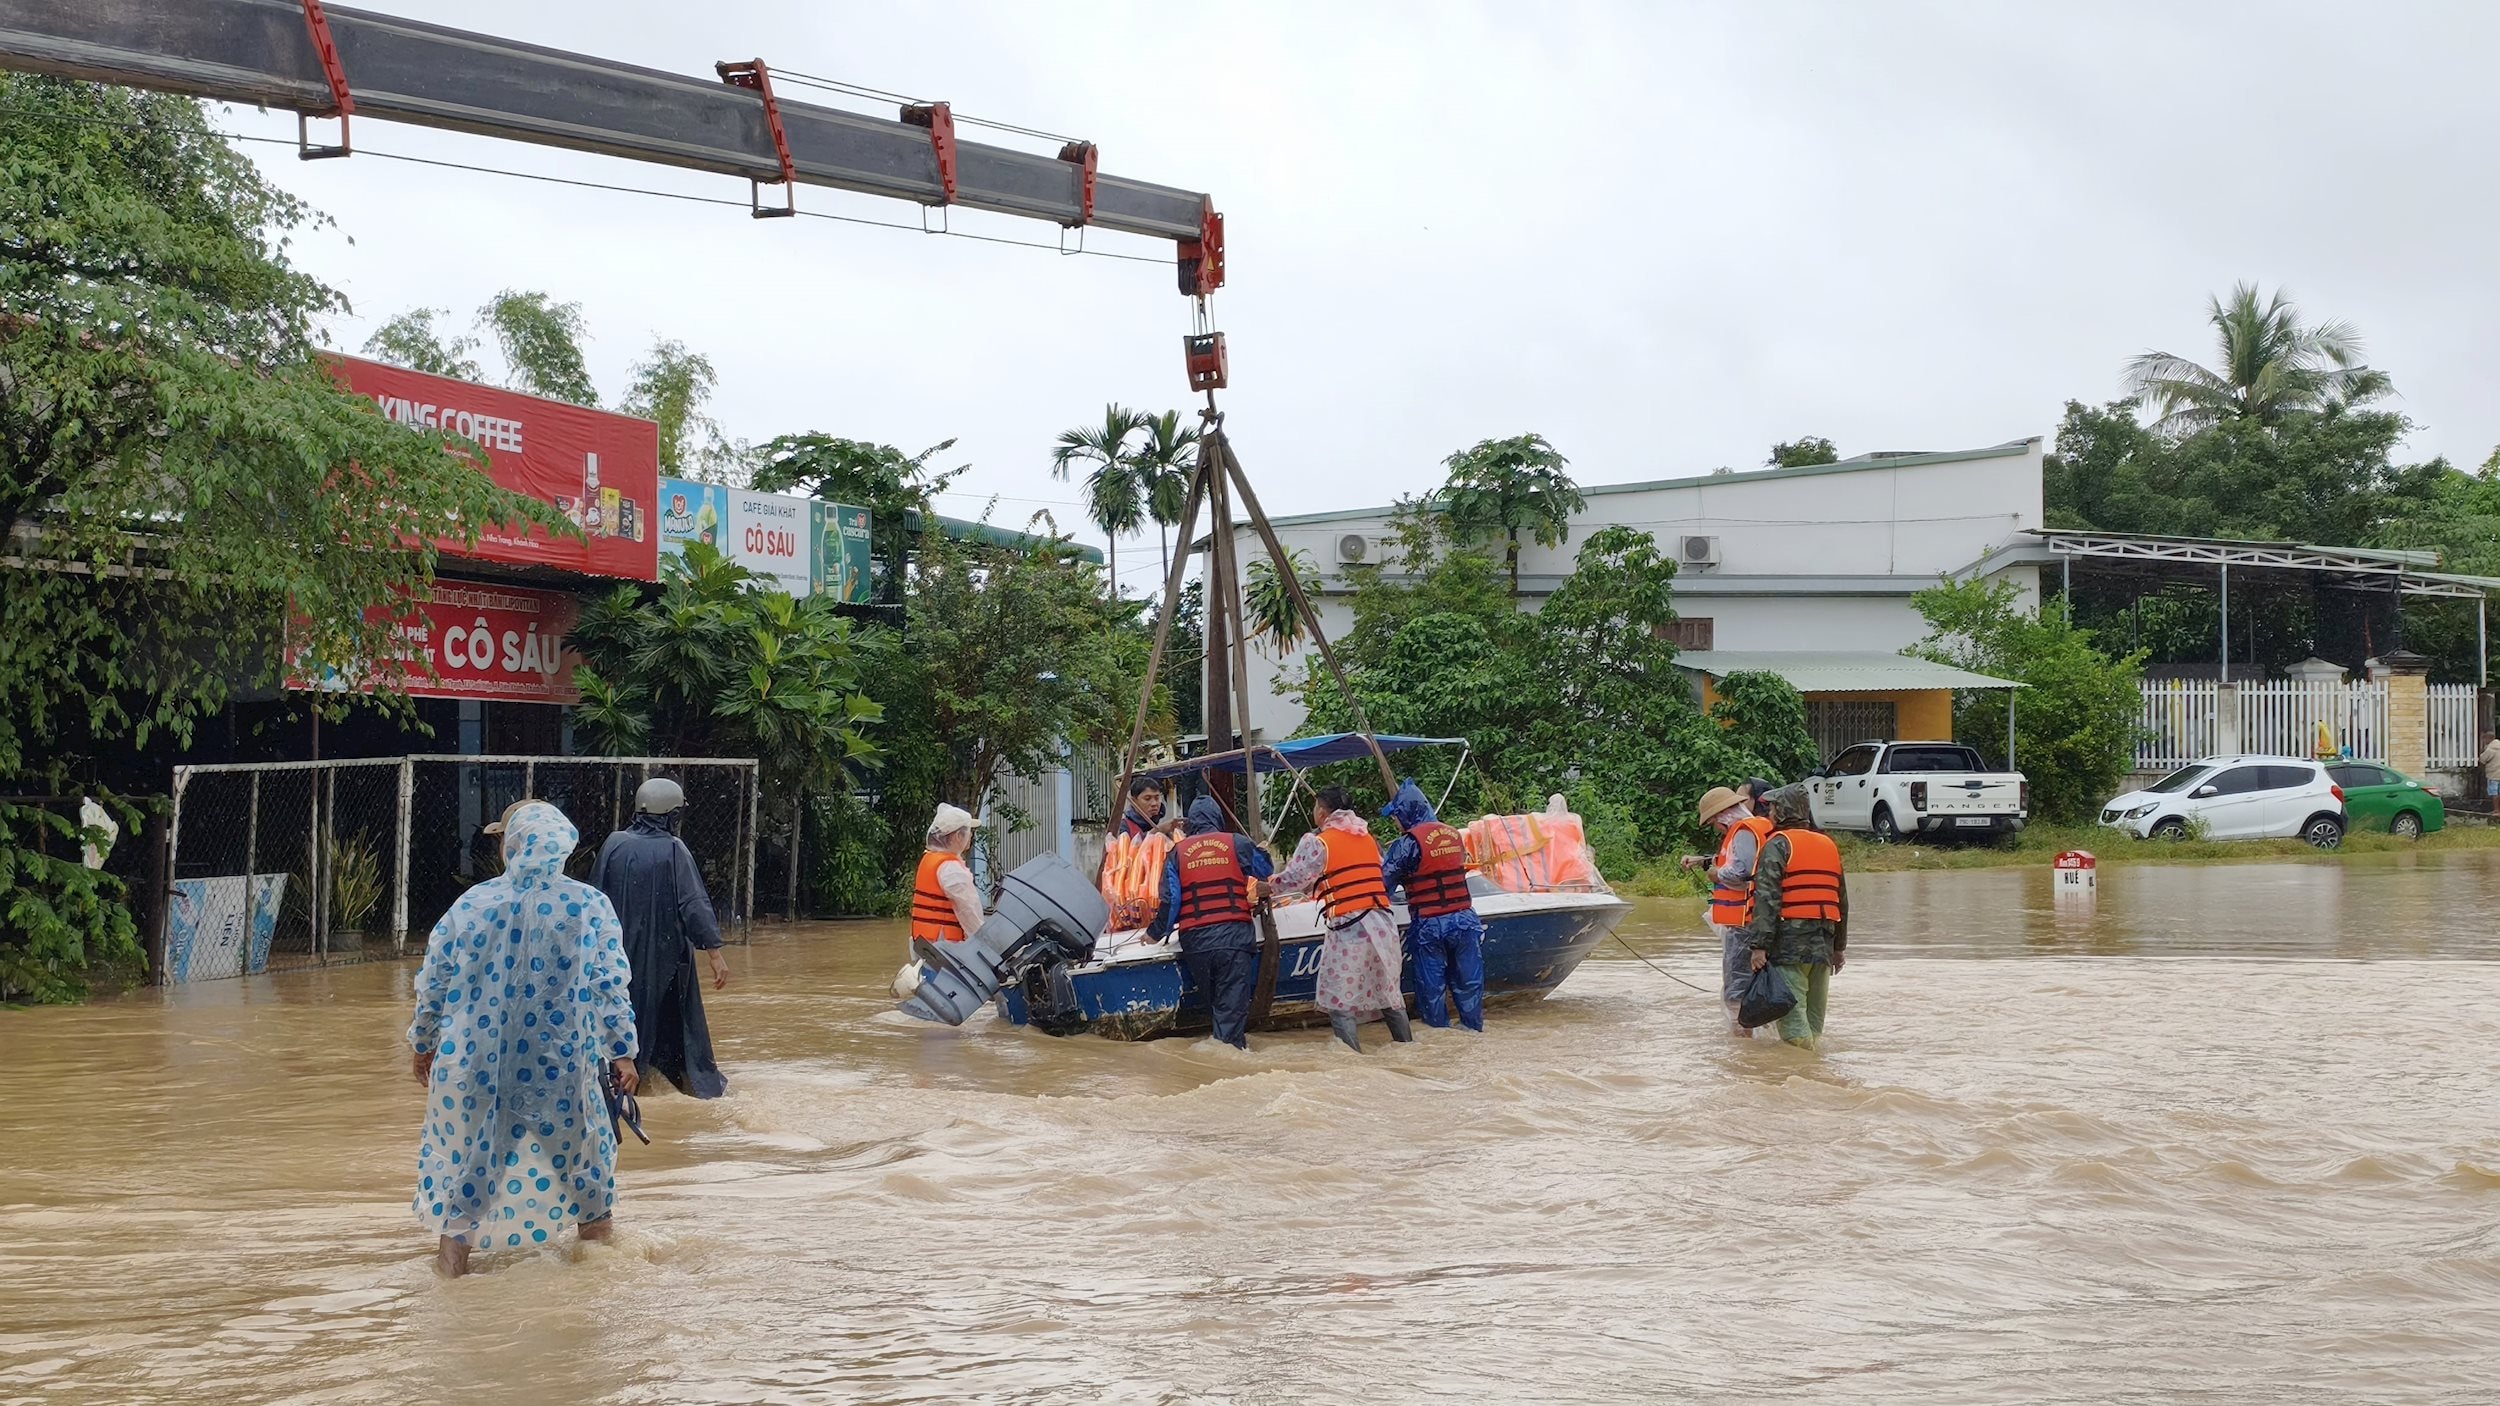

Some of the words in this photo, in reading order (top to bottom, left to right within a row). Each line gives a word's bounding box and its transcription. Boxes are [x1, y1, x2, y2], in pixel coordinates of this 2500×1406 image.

[378, 395, 437, 438] KING
[440, 408, 523, 453] COFFEE
[745, 522, 764, 554] CÔ
[767, 526, 795, 557] SÁU
[407, 624, 429, 643] PHÊ
[444, 616, 496, 670] CÔ
[501, 622, 563, 675] SÁU
[1184, 841, 1203, 857] LONG
